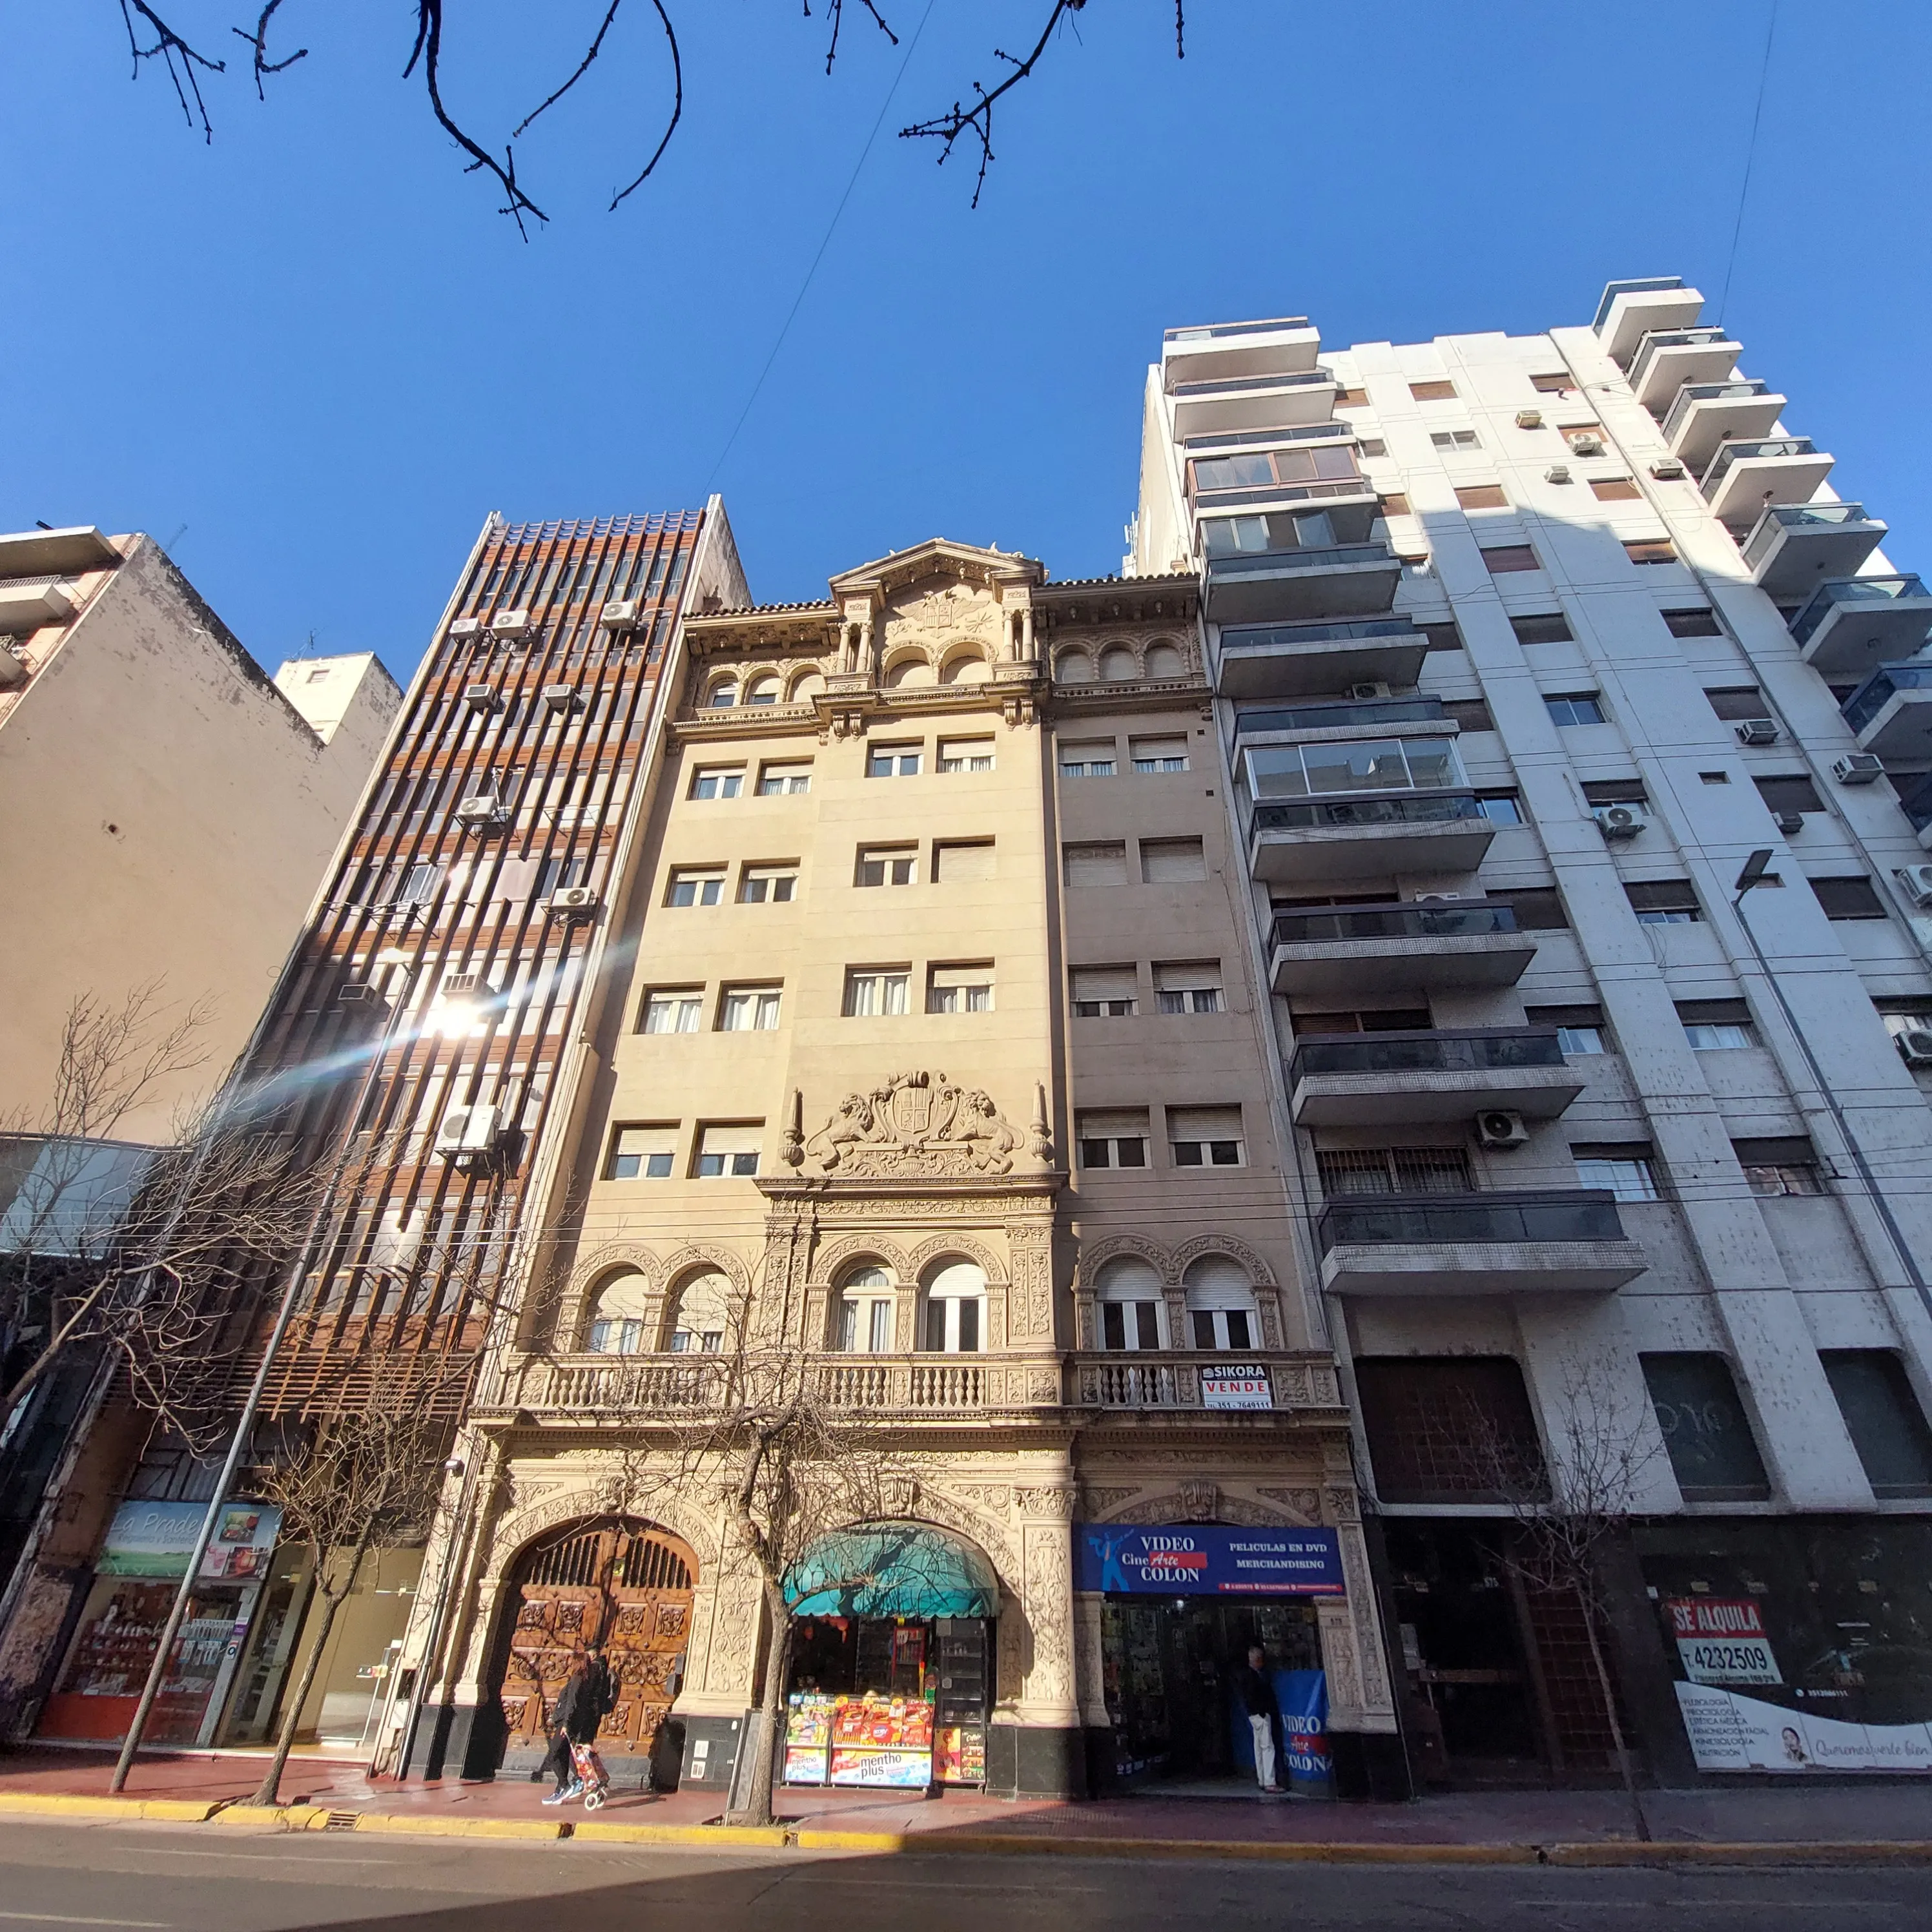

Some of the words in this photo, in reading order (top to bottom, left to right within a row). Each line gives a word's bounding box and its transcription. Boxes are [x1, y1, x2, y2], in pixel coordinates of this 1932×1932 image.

[1214, 1365, 1266, 1377] SIKORA
[1206, 1382, 1266, 1392] VENDE
[110, 1511, 135, 1533] La
[1140, 1536, 1195, 1551] VIDEO
[1229, 1543, 1286, 1552] PELICULAS
[1288, 1543, 1303, 1552] EN
[1306, 1543, 1328, 1552] DVD
[1122, 1553, 1149, 1566] Cine
[1150, 1552, 1178, 1566] Arte
[1236, 1559, 1324, 1568] MERCHANDISING
[1140, 1567, 1200, 1582] COLON
[1673, 1606, 1696, 1631] SE
[1696, 1605, 1762, 1634] ALQUILA
[1694, 1646, 1768, 1670] 4232509
[1282, 1713, 1321, 1734] VIDEO
[792, 1756, 817, 1766] mentho
[861, 1752, 902, 1767] mentho
[792, 1763, 807, 1773] plus
[861, 1766, 885, 1780] plus
